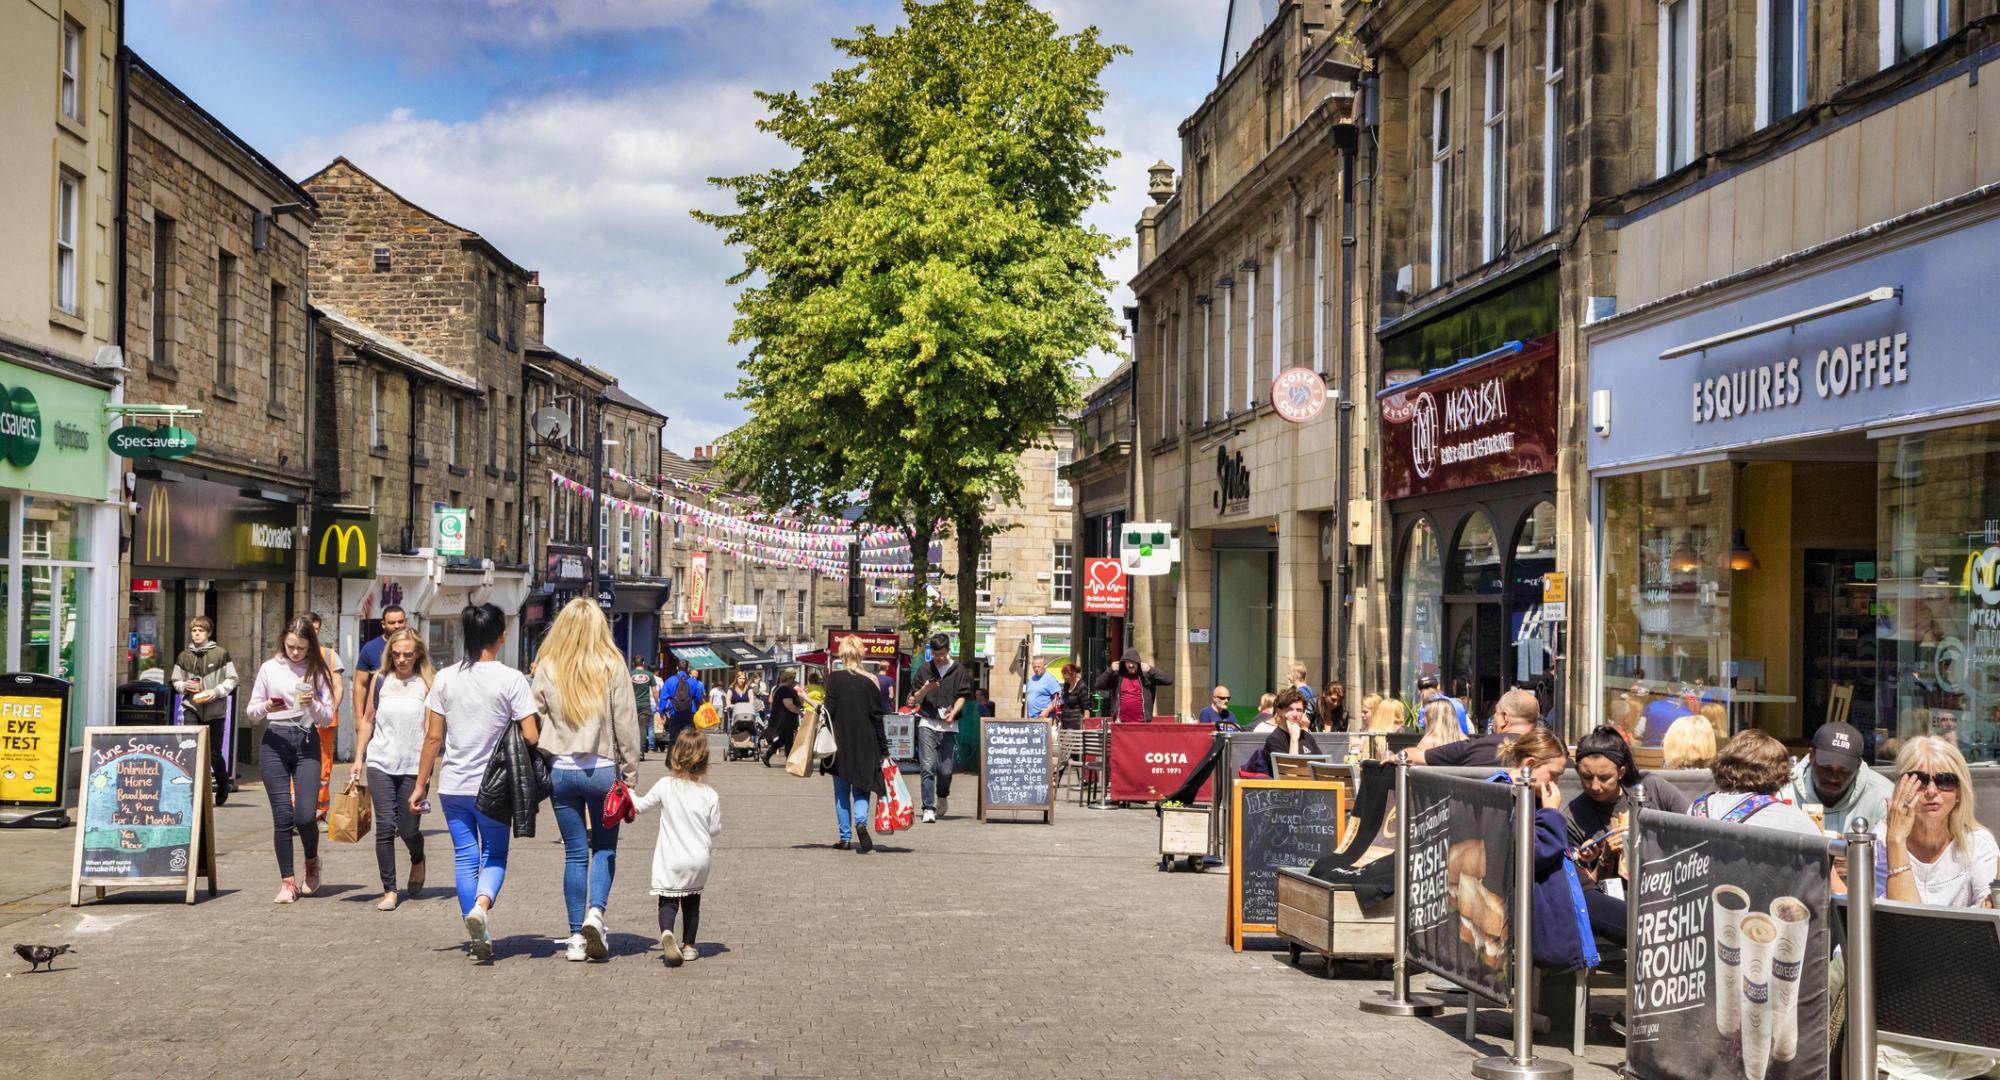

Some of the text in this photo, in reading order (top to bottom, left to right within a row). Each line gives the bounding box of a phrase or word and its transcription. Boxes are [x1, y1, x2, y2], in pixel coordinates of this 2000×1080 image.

[1281, 372, 1315, 387] COSTA
[1692, 332, 1908, 422] ESQUIRES COFFEE
[1280, 399, 1321, 417] COFFEE
[1444, 377, 1507, 434] MEDUSA
[116, 434, 188, 450] Specsavers
[251, 523, 293, 550] McDonald's
[870, 645, 895, 654] £4.00
[876, 638, 896, 646] Burger
[2, 703, 43, 718] FREE
[7, 720, 37, 734] EYE
[1, 736, 41, 750] TEST
[1832, 738, 1850, 750] CLUB
[1835, 732, 1849, 741] THE
[94, 744, 123, 765] June
[1144, 752, 1188, 765] COSTA
[117, 761, 160, 776] Unlimited
[125, 776, 153, 787] Home
[117, 788, 160, 800] Broadband
[135, 802, 155, 812] Price
[120, 829, 135, 840] Yes
[1640, 852, 1710, 898] Every Coffee
[1637, 896, 1710, 947] FRESHLY
[1636, 936, 1708, 981] GROUND
[1633, 970, 1706, 1010] TO ORDER
[1747, 983, 1768, 1000] GREGGS
